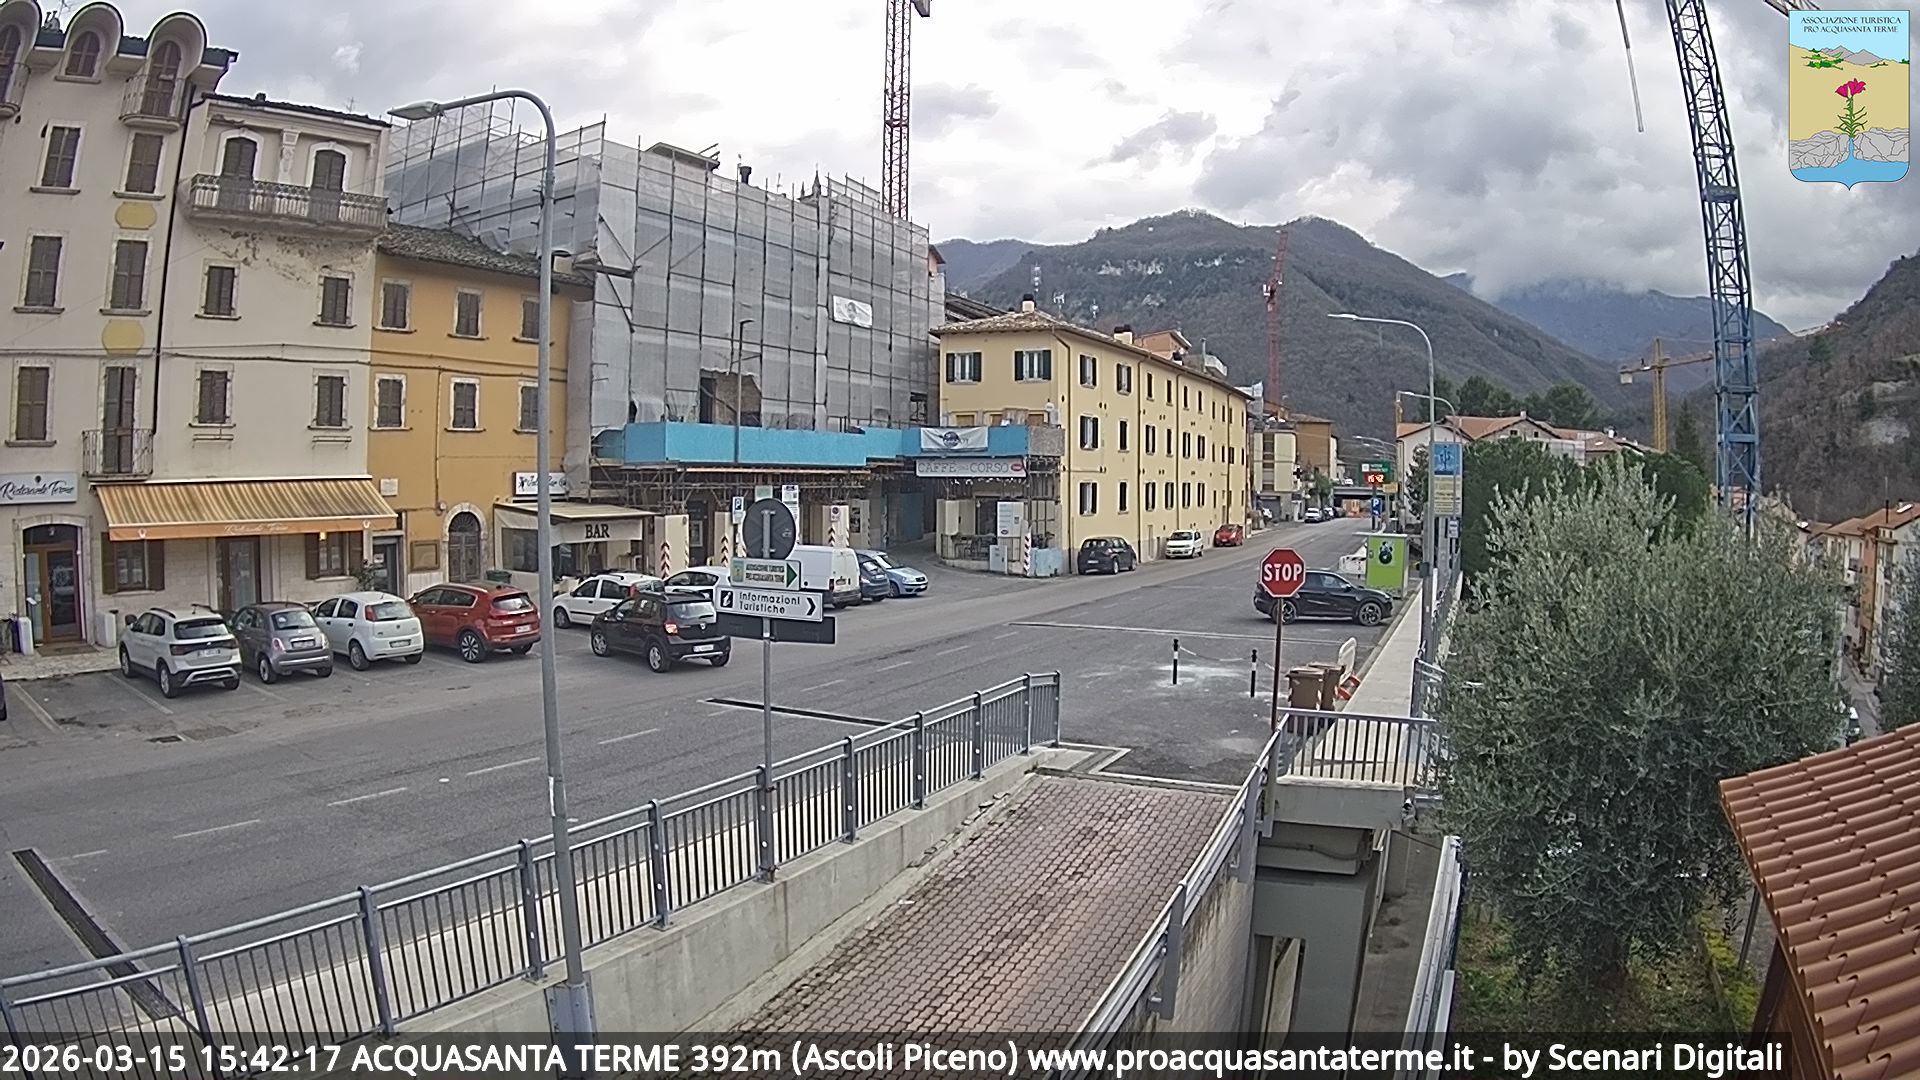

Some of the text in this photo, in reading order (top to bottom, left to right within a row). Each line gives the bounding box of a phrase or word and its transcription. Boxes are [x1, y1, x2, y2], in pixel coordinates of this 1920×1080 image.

[969, 463, 1009, 473] CORSO
[585, 524, 610, 539] BAR
[1263, 563, 1303, 582] STOP
[739, 592, 800, 605] Informazioni
[739, 601, 785, 614] Turistiche
